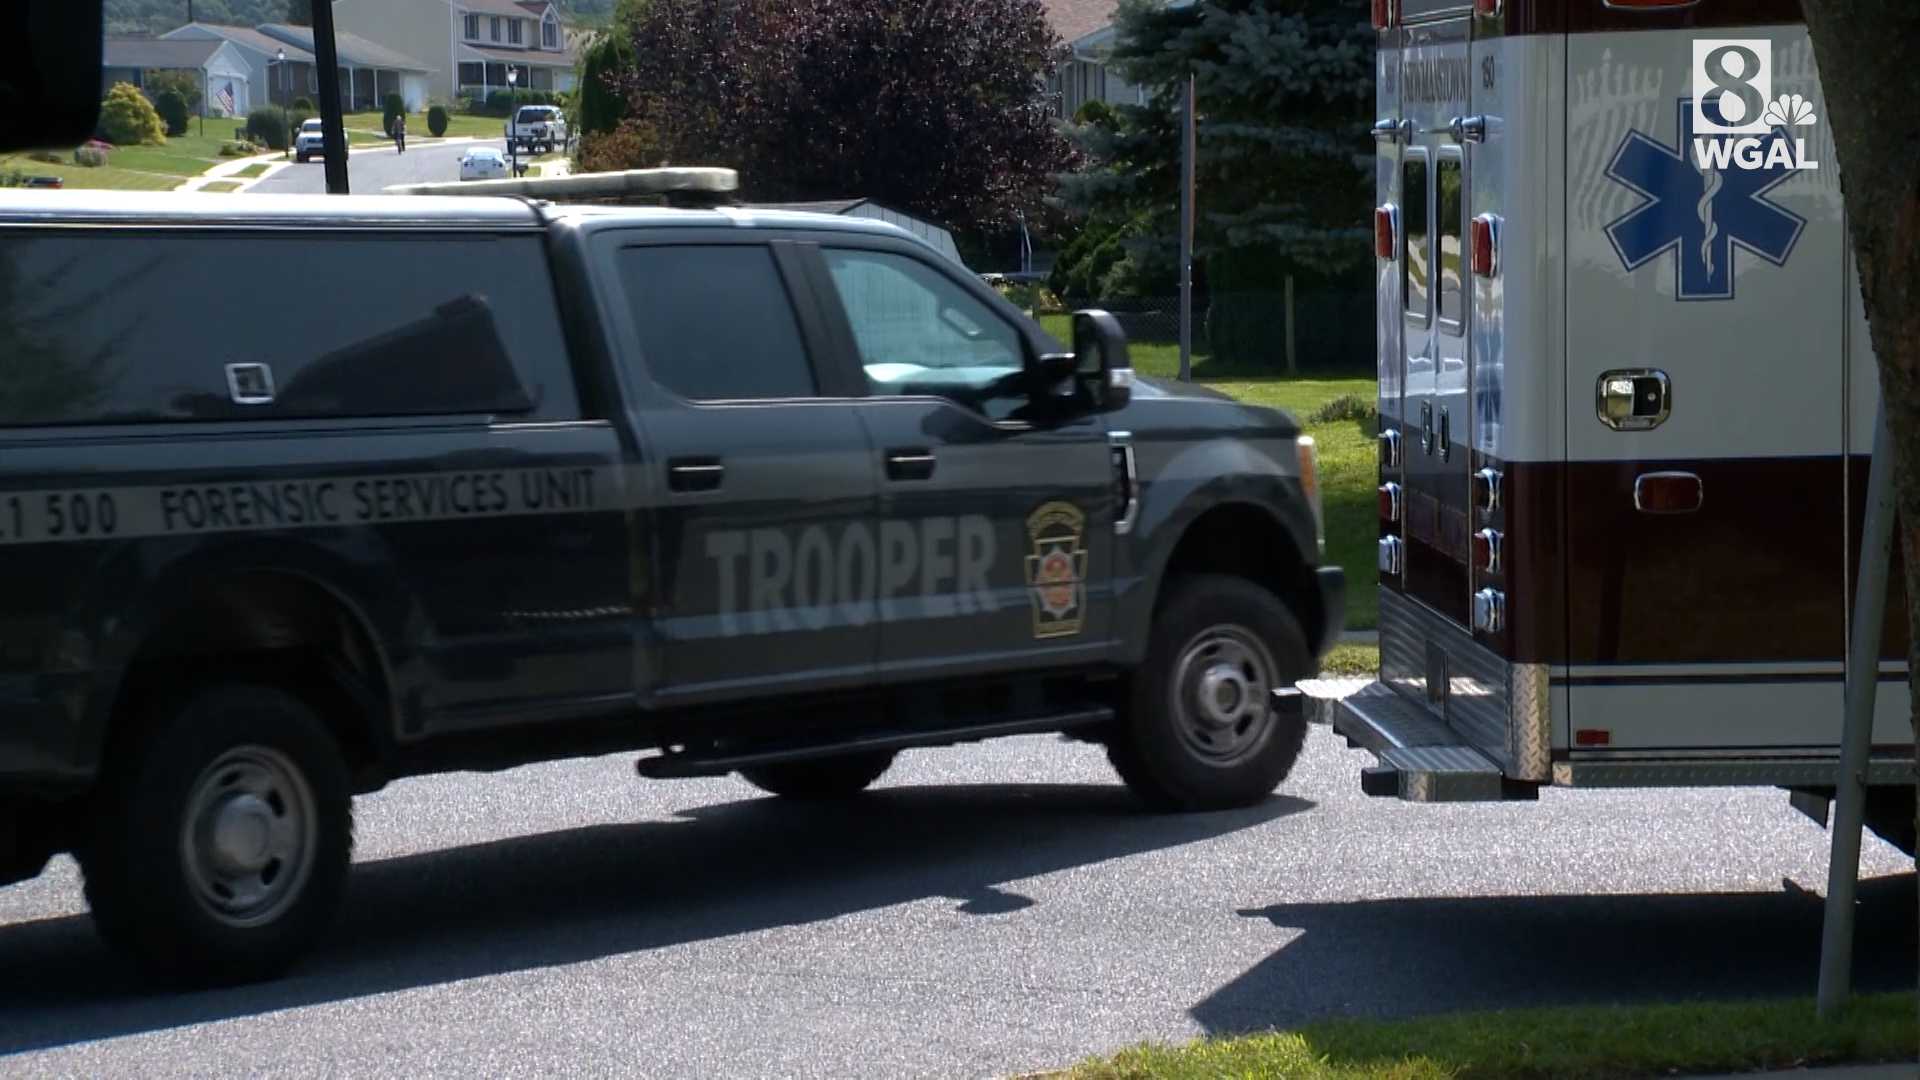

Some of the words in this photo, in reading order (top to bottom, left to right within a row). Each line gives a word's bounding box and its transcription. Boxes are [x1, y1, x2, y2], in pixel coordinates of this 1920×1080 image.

[46, 492, 117, 536] 500
[161, 480, 340, 532] FORENSIC
[352, 470, 509, 520] SERVICES
[520, 466, 596, 510] UNIT
[706, 514, 998, 638] TROOPER
